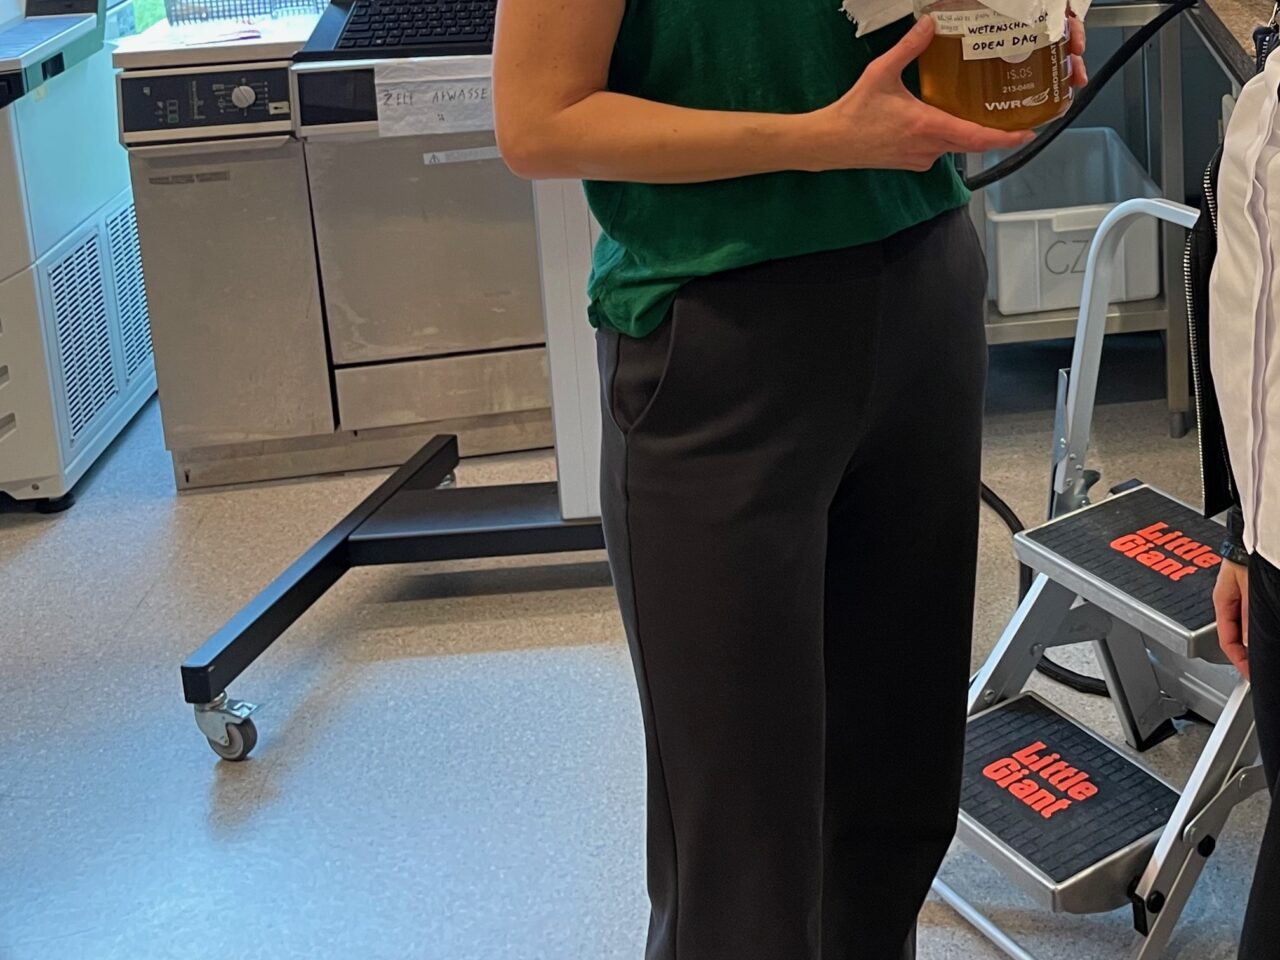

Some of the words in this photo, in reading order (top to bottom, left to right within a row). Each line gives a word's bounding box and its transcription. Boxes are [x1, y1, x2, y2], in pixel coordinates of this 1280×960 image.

[972, 39, 1005, 51] OPEN
[1012, 34, 1038, 46] DAG
[984, 100, 1021, 111] VWR
[1109, 533, 1200, 581] Giant
[1136, 521, 1222, 568] Little
[982, 757, 1072, 819] Giant
[1012, 741, 1098, 801] Little
